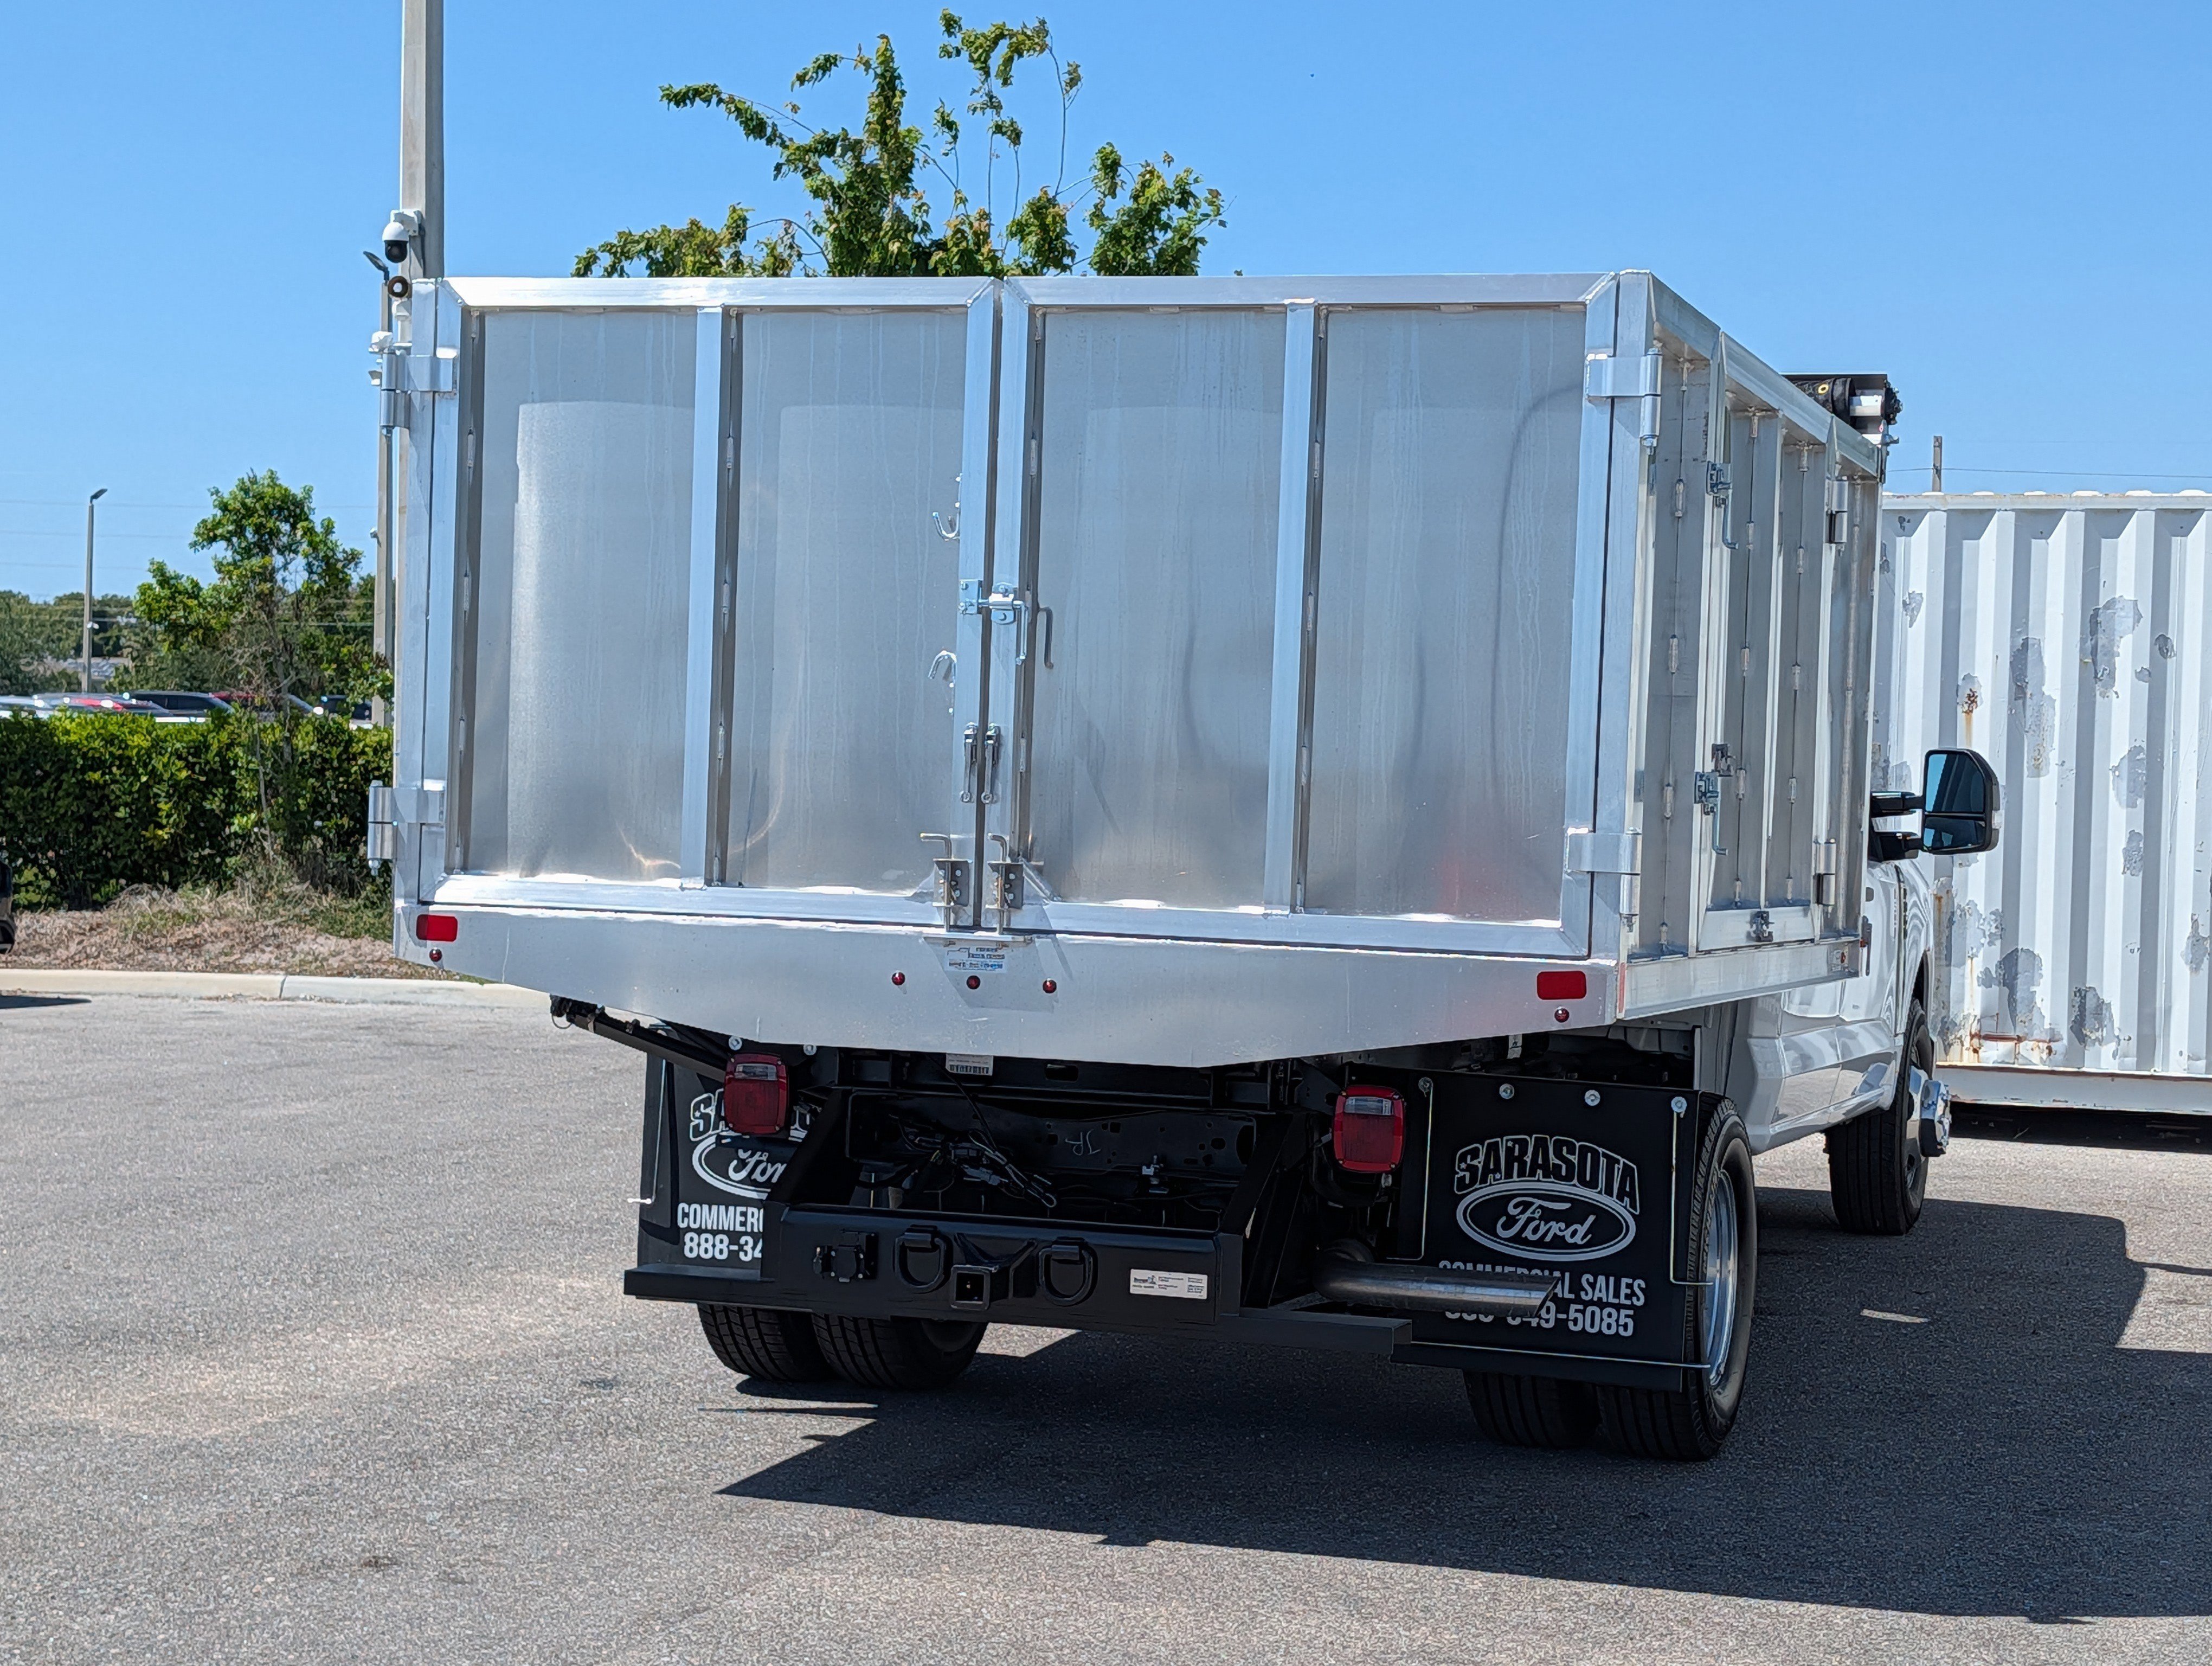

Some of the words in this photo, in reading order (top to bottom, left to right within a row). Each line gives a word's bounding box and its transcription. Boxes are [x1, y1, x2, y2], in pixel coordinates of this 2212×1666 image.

[728, 1149, 787, 1183] For
[1454, 1135, 1639, 1215] SARASOTA
[678, 1202, 763, 1233] COMMER
[1496, 1197, 1596, 1245] Ford
[684, 1232, 763, 1262] 888-34
[1580, 1273, 1645, 1306] SALES
